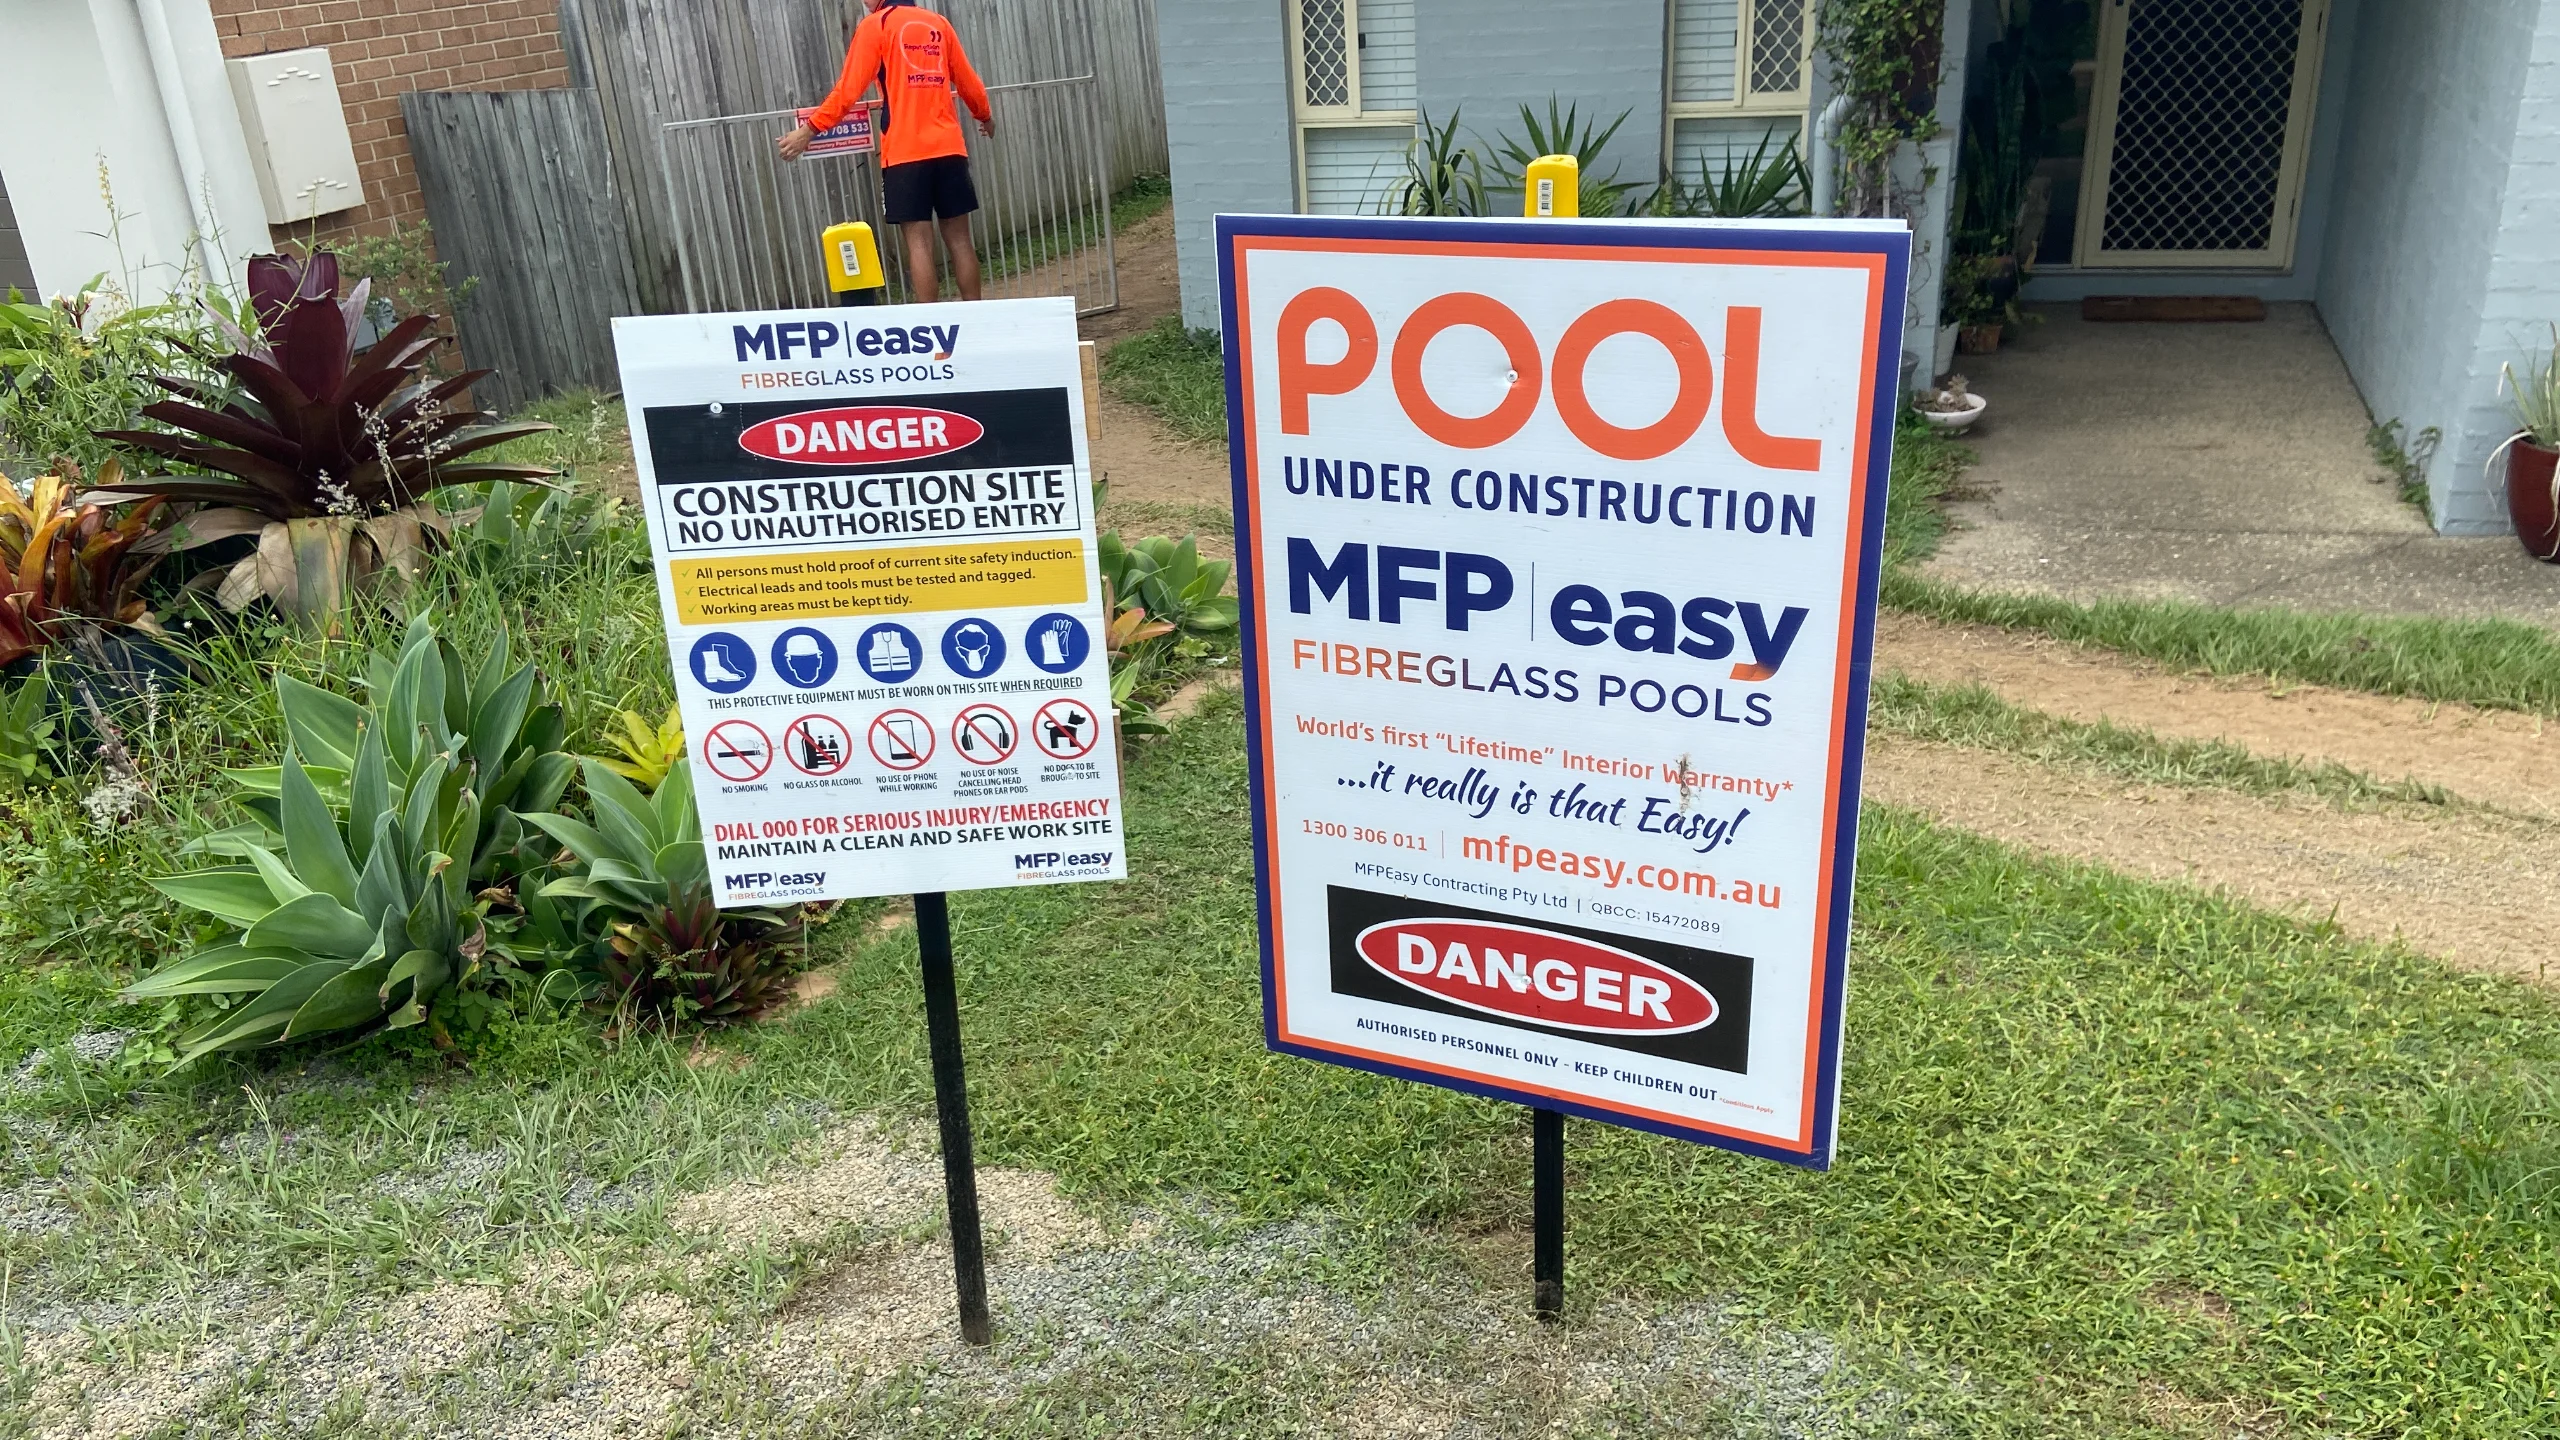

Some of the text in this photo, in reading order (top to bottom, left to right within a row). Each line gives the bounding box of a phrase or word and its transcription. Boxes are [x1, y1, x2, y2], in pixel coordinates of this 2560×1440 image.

[852, 122, 868, 132] 533
[733, 322, 959, 363] MFP easy
[741, 365, 954, 389] FIBREGLASS POOLS
[1277, 286, 1822, 472] POOL
[775, 417, 950, 455] DANGER
[673, 471, 1064, 518] CONSTRUCTION SITE
[1284, 456, 1816, 537] UNDER CONSTRUCTION
[680, 502, 1065, 544] NO UNAUTHORISED ENTRY
[696, 549, 1076, 580] All persons must hold proof of current site safety induction.
[699, 569, 1035, 596] Electrical leads and tools must be tested and tagged.
[702, 594, 912, 615] Working areas must be kept tidy.
[1287, 536, 1810, 681] MFP easy
[708, 677, 1082, 709] THIS PROTECTIVE EQUIPMENT MUST BE WORN ON THIS SITE WHEN REQUIRED
[1293, 639, 1772, 726] FIBREGLASS POOLS
[1044, 765, 1054, 773] NO
[1086, 762, 1095, 770] BE
[1382, 726, 1429, 751] first
[1562, 750, 1654, 782] Interior
[734, 784, 768, 793] SMOKING
[784, 778, 863, 790] NO GLASS OR ALCOHOL
[879, 783, 937, 792] WHILE WORKING
[903, 774, 912, 782] OF
[914, 773, 938, 781] PHONE
[954, 789, 982, 797] PHONES
[959, 777, 1021, 787] CANCELLING HEAD
[1041, 773, 1075, 782] BROUG
[715, 799, 1110, 841] DIAL 000 FOR SERIOUS INJURY/EMERGENCY
[1405, 768, 1499, 818] really
[1511, 782, 1538, 815] is
[1549, 783, 1626, 826] that
[1638, 798, 1751, 853] Easy!
[718, 820, 1112, 860] MAINTAIN A CLEAN AND SAFE WORK SITE
[1015, 852, 1113, 869] MFP easy
[1017, 867, 1110, 880] FIBREGLASS POOLS
[1303, 819, 1781, 910] 1300 306 011 mfpeasy.com.au
[725, 872, 826, 889] MFP easy
[729, 890, 788, 900] FIBREGLASS
[1355, 862, 1721, 934] MFPEasy Contracting Pty Ltd QBCC: 15472089
[1397, 932, 1674, 1023] DANGER
[1357, 1018, 1437, 1043] AUTHORISED
[1442, 1034, 1519, 1060] PERSONNEL
[1524, 1051, 1559, 1069] ONLY
[1575, 1061, 1609, 1079] KEEP
[1614, 1070, 1684, 1096] CHILDREN
[1689, 1086, 1717, 1102] OUT
